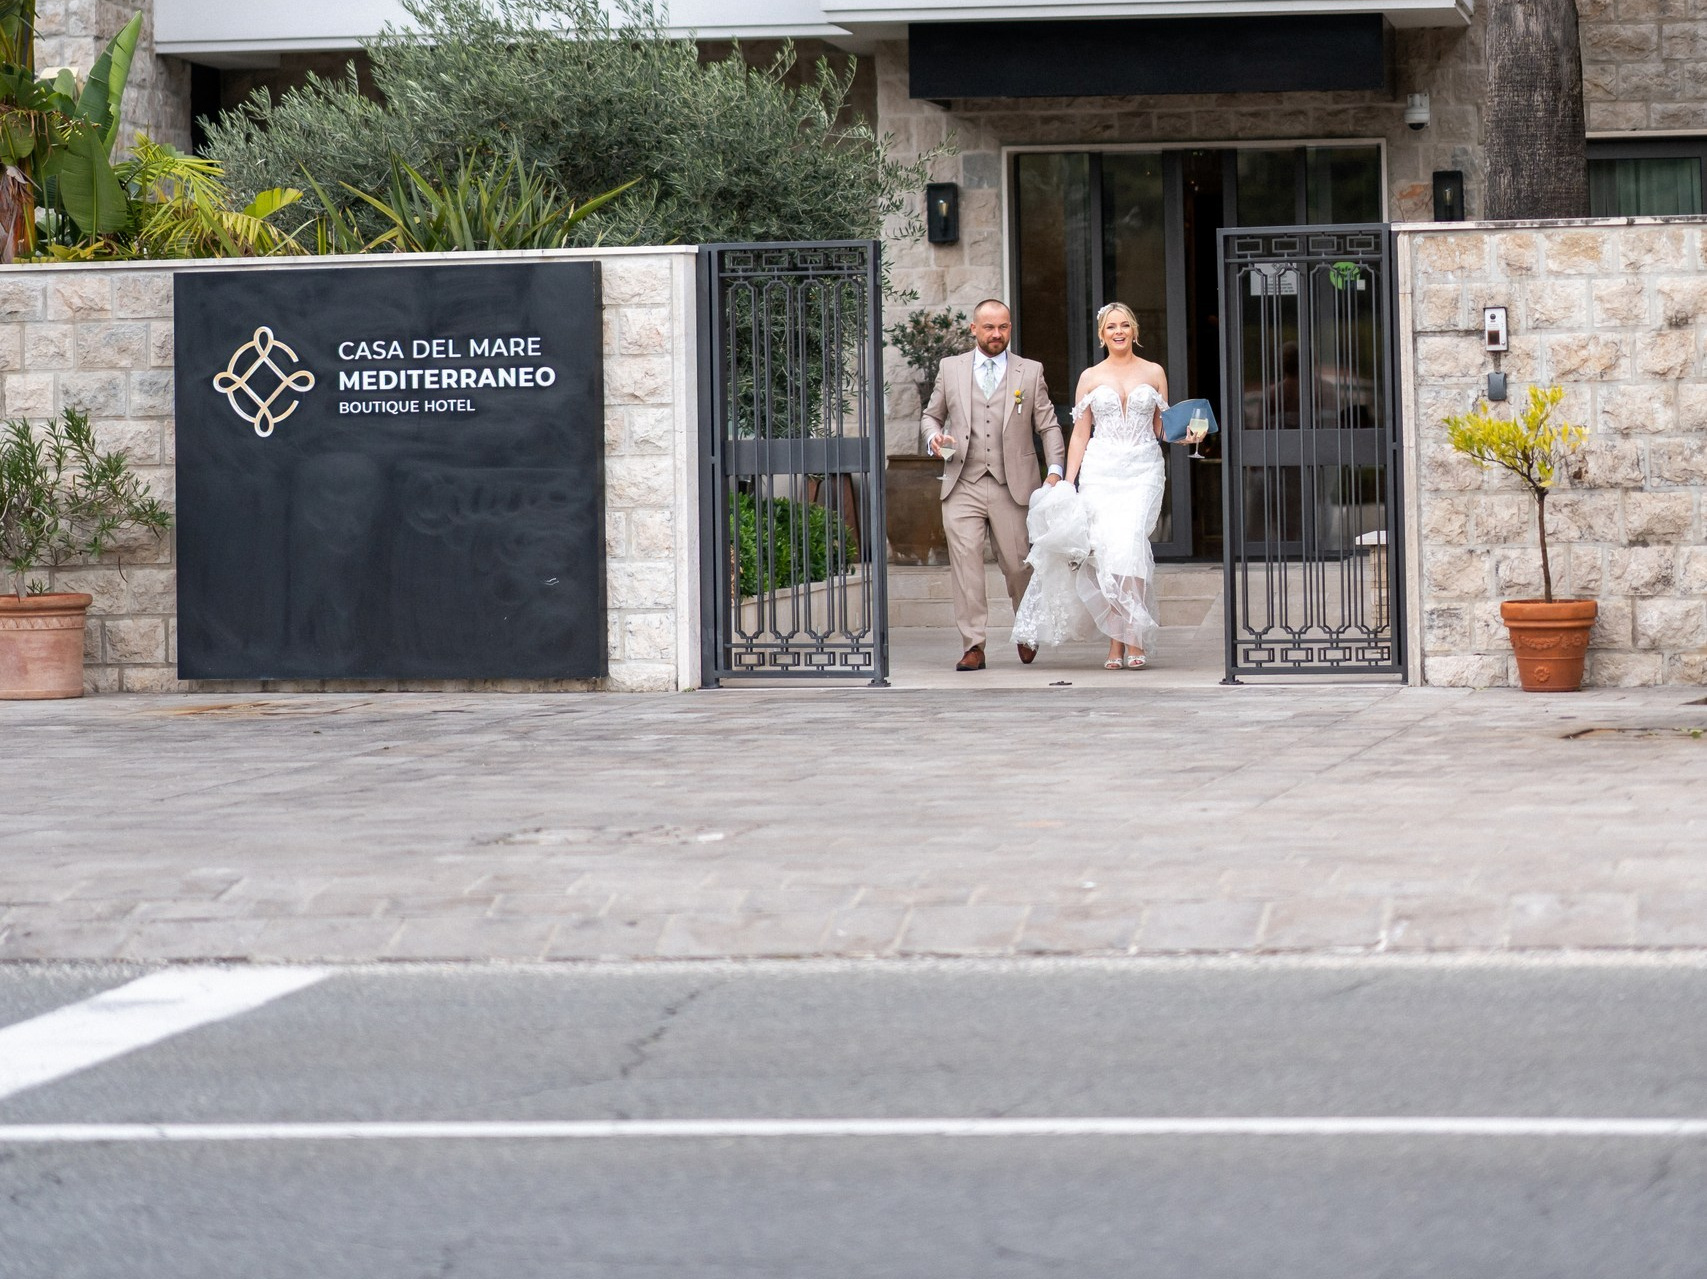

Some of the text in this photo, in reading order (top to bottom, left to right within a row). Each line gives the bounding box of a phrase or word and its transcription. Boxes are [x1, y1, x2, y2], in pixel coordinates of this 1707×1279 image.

[338, 336, 542, 361] CASA DEL MARE
[338, 366, 556, 391] MEDITERRANEO
[339, 399, 476, 415] BOUTIQUE HOTEL
